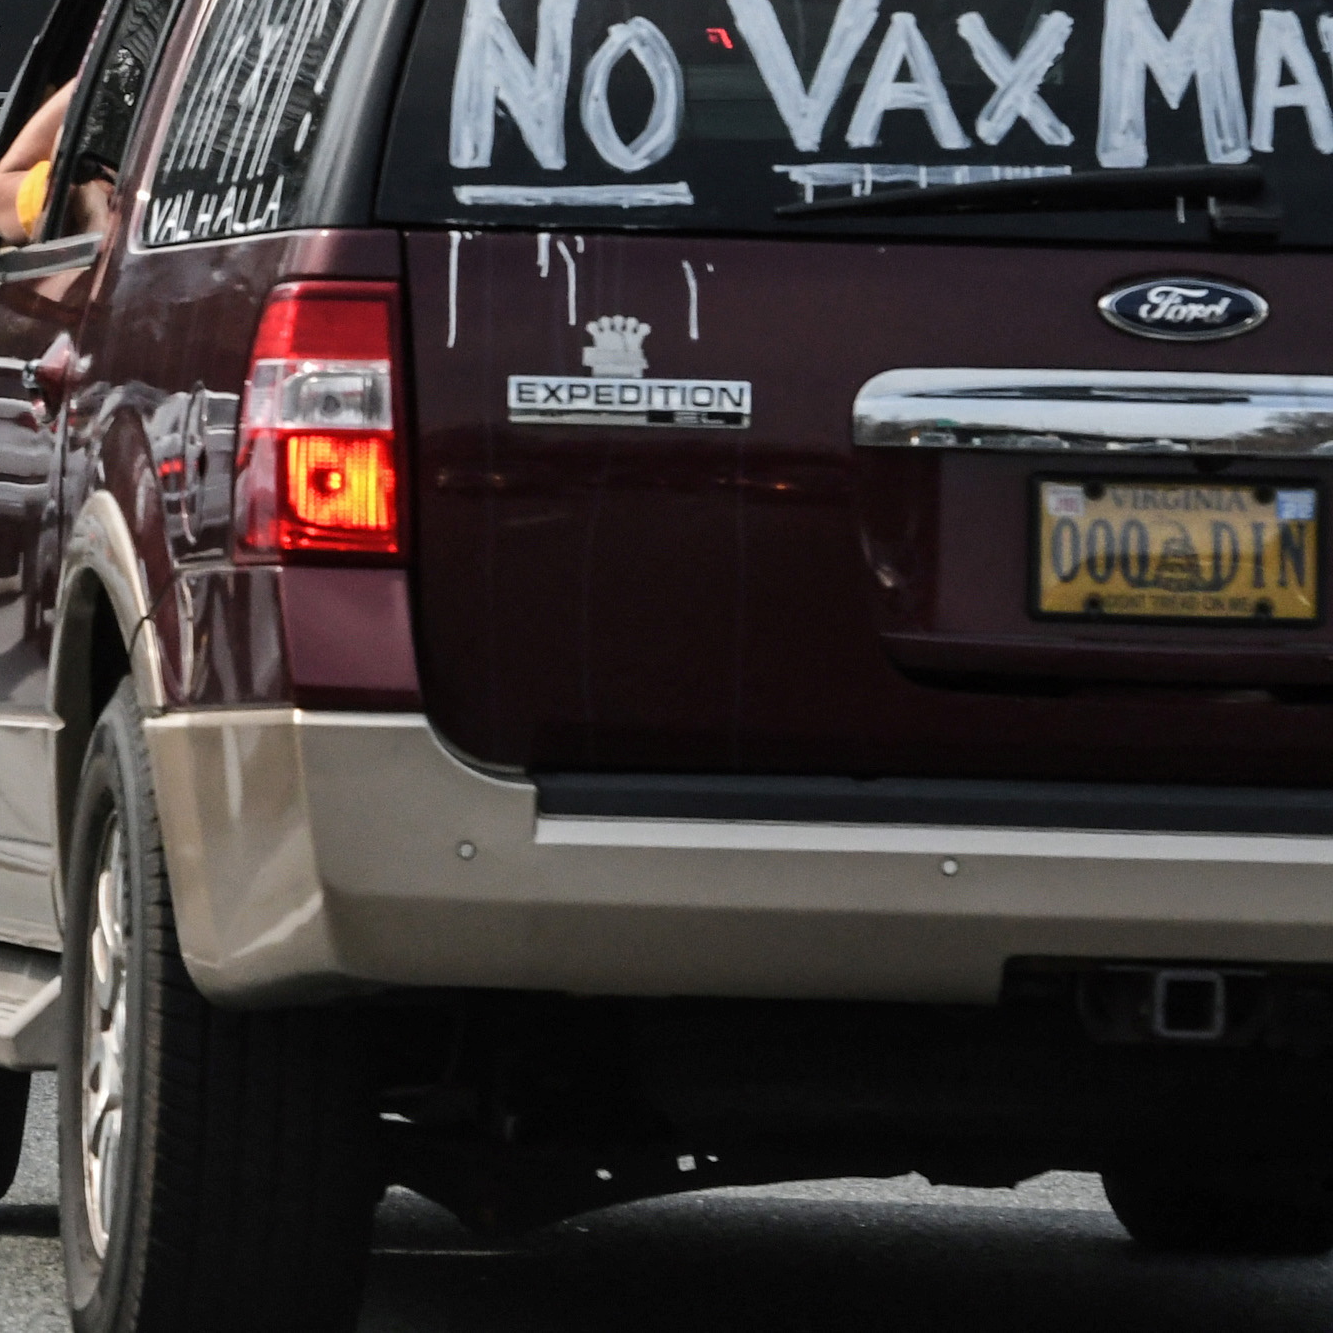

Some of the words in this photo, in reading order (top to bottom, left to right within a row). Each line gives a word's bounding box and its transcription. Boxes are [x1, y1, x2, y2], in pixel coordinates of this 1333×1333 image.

[148, 174, 284, 243] VALHALLA
[1138, 285, 1233, 324] Ford
[516, 381, 744, 408] EXPEDITION
[1109, 487, 1249, 513] VIRGINIA
